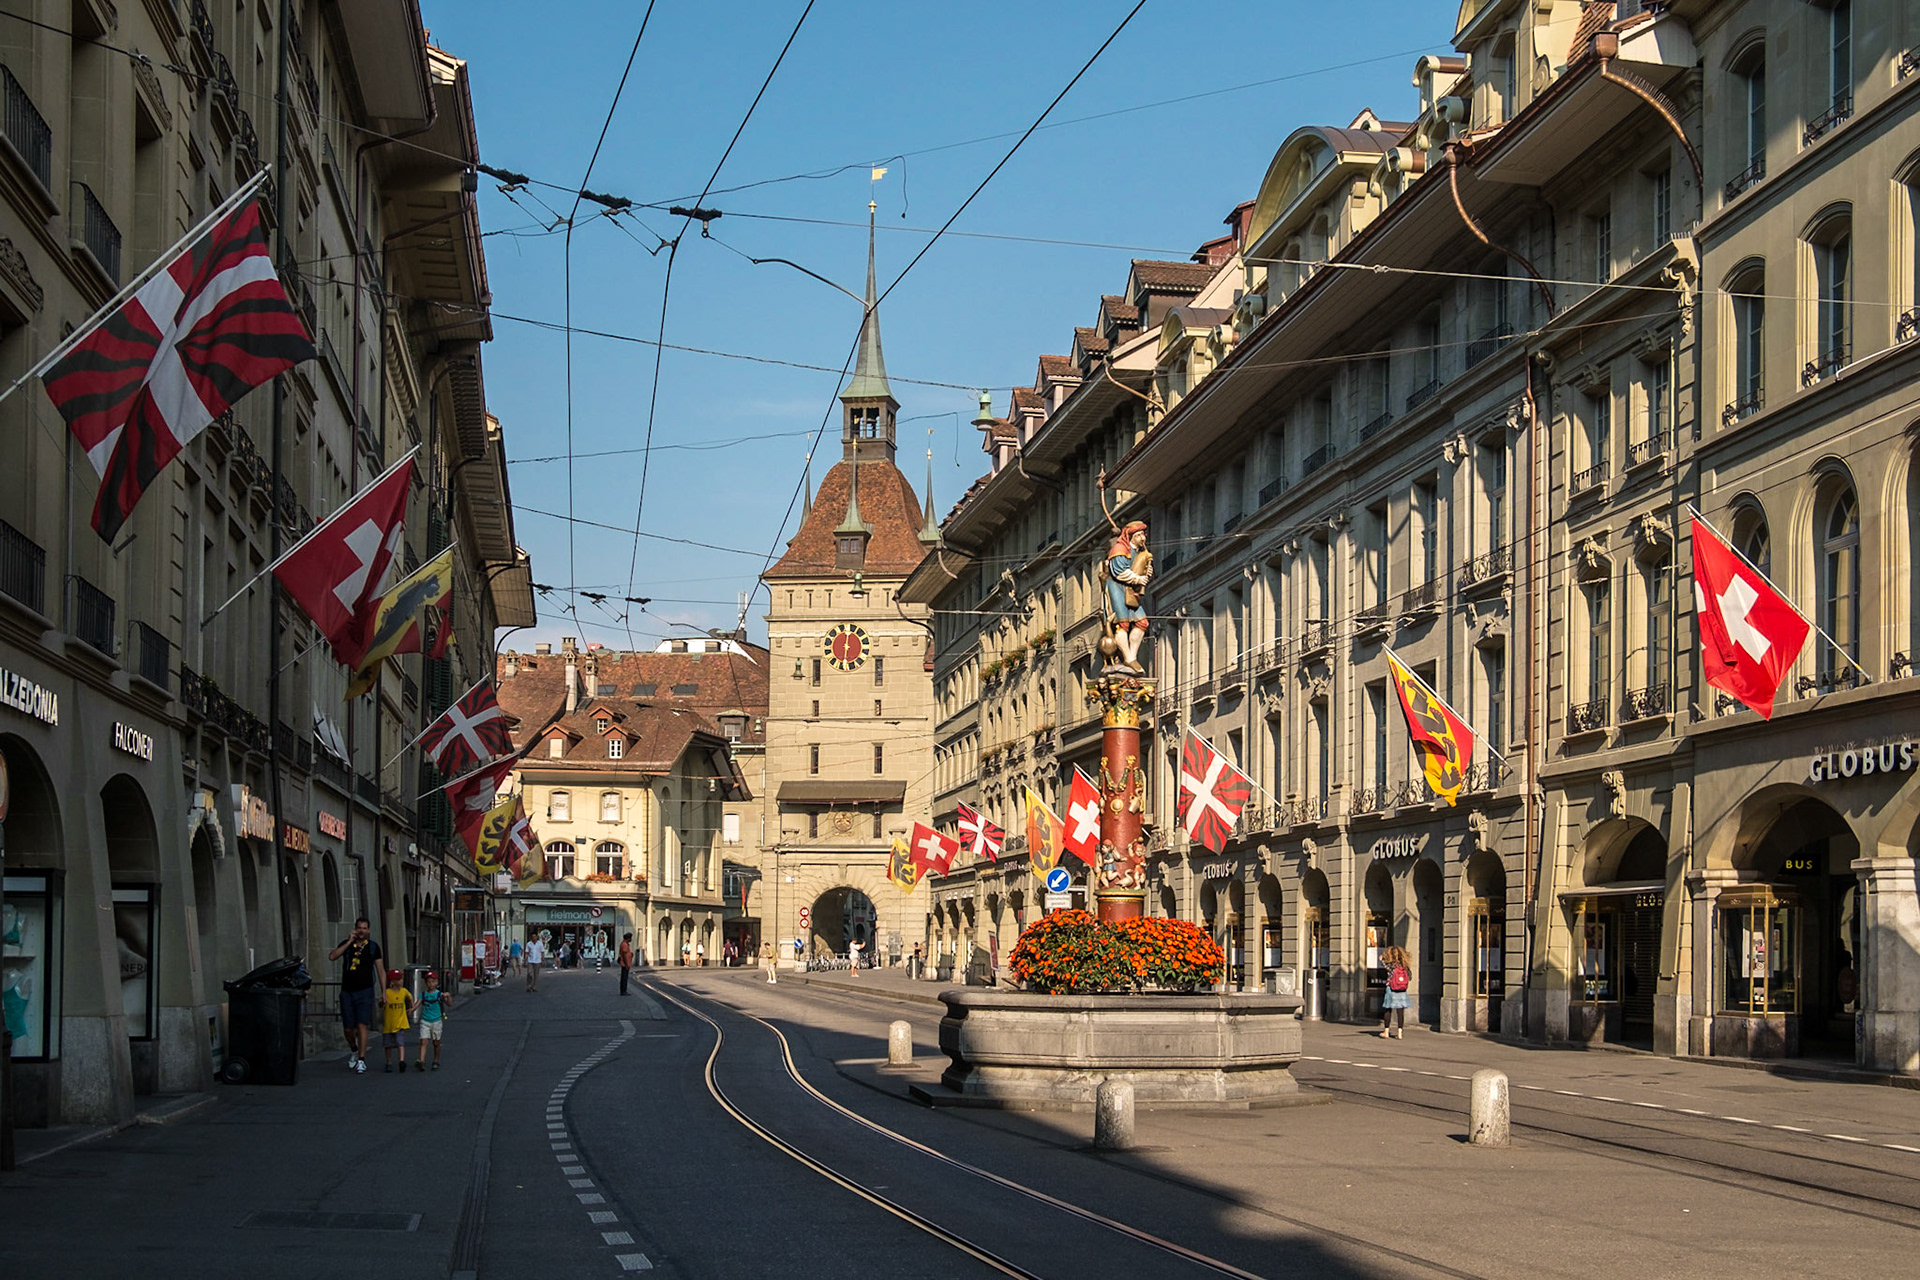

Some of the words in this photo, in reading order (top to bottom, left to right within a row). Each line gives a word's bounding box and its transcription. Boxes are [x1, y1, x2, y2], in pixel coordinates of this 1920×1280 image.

[115, 721, 153, 762] FALCONERI
[1809, 741, 1912, 782] GLOBUS
[1372, 837, 1417, 860] GLOBUS
[1202, 862, 1231, 880] GLOBUS
[1635, 893, 1663, 907] GLOB
[550, 908, 591, 920] fielmann
